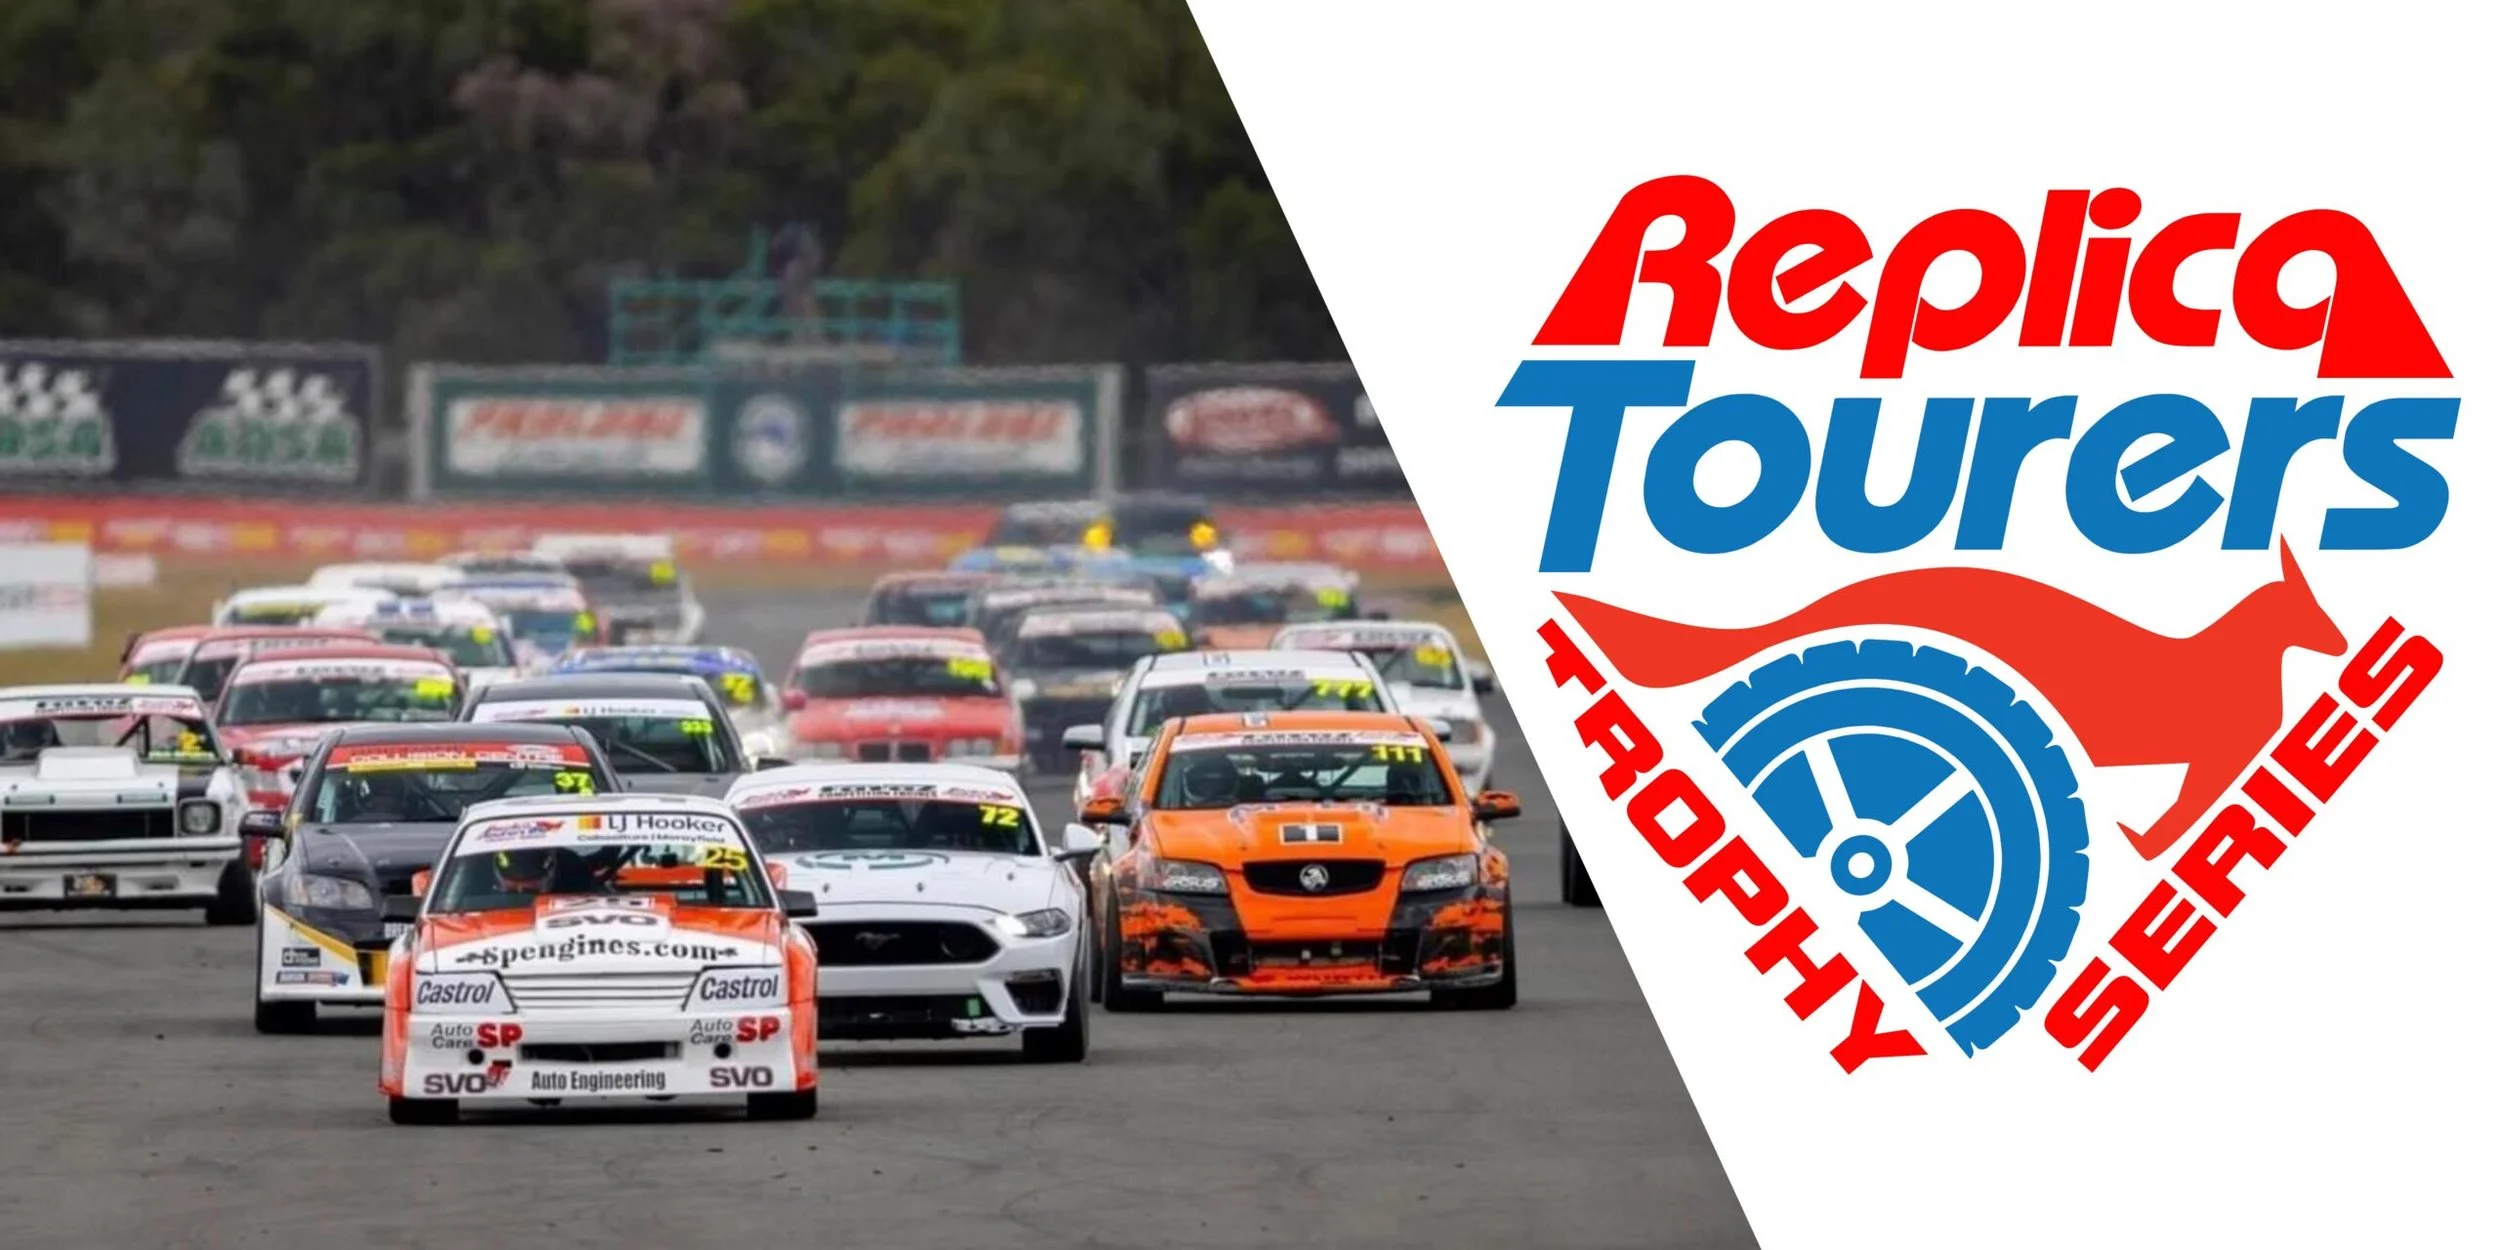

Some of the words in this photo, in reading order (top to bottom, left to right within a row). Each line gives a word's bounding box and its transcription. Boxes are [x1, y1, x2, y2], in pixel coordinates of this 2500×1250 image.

[608, 815, 628, 832] LJ
[636, 814, 726, 833] Hooker
[979, 804, 1020, 827] 72
[703, 847, 749, 870] 25
[546, 914, 658, 929] SVO
[417, 979, 496, 1005] Castrol
[700, 973, 779, 1001] Castrol
[430, 1022, 474, 1037] Auto
[476, 1022, 523, 1048] SP
[690, 1018, 734, 1034] Auto
[736, 1016, 781, 1043] SP
[431, 1035, 474, 1050] Care
[690, 1032, 733, 1046] Care
[423, 1072, 487, 1095] SVO
[531, 1070, 568, 1091] Auto
[570, 1069, 666, 1092] Engineering
[709, 1066, 774, 1088] SVO
